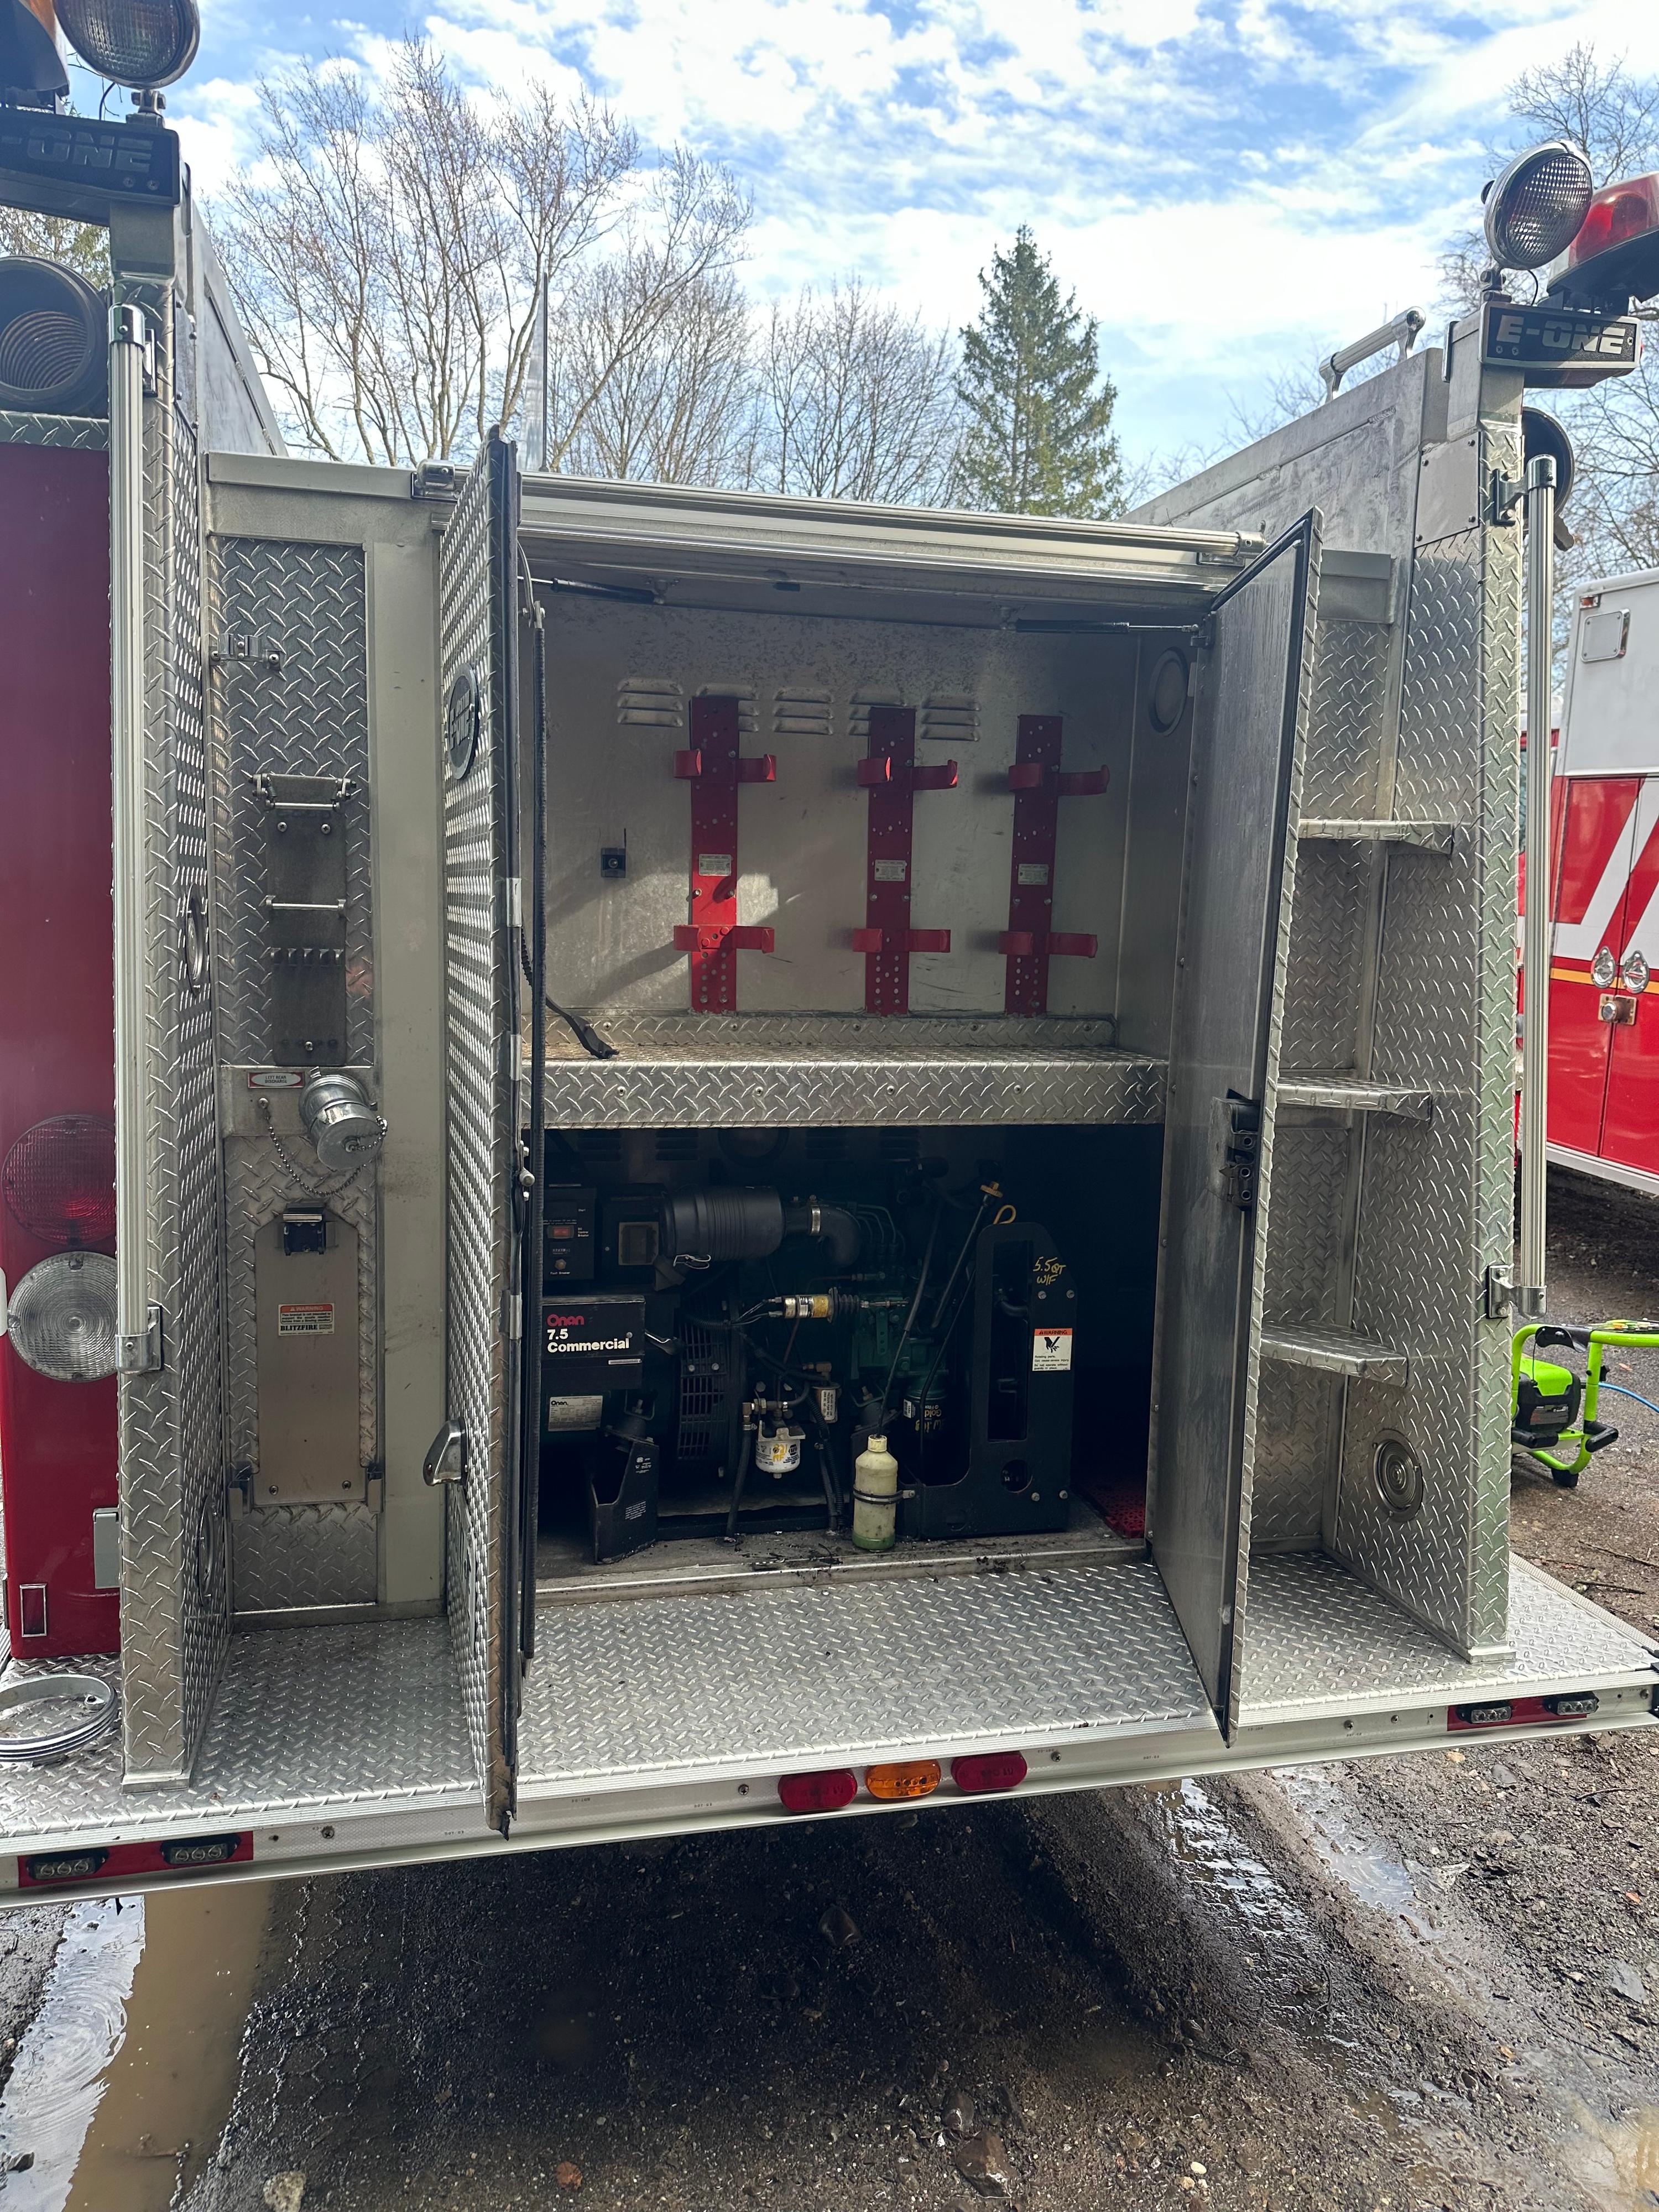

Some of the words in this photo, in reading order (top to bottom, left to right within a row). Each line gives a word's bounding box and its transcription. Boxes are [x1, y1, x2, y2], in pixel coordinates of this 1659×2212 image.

[1496, 314, 1626, 354] E-ONE
[547, 1313, 585, 1327] Onan
[547, 1328, 569, 1340] 7.5
[547, 1338, 630, 1353] Commercial
